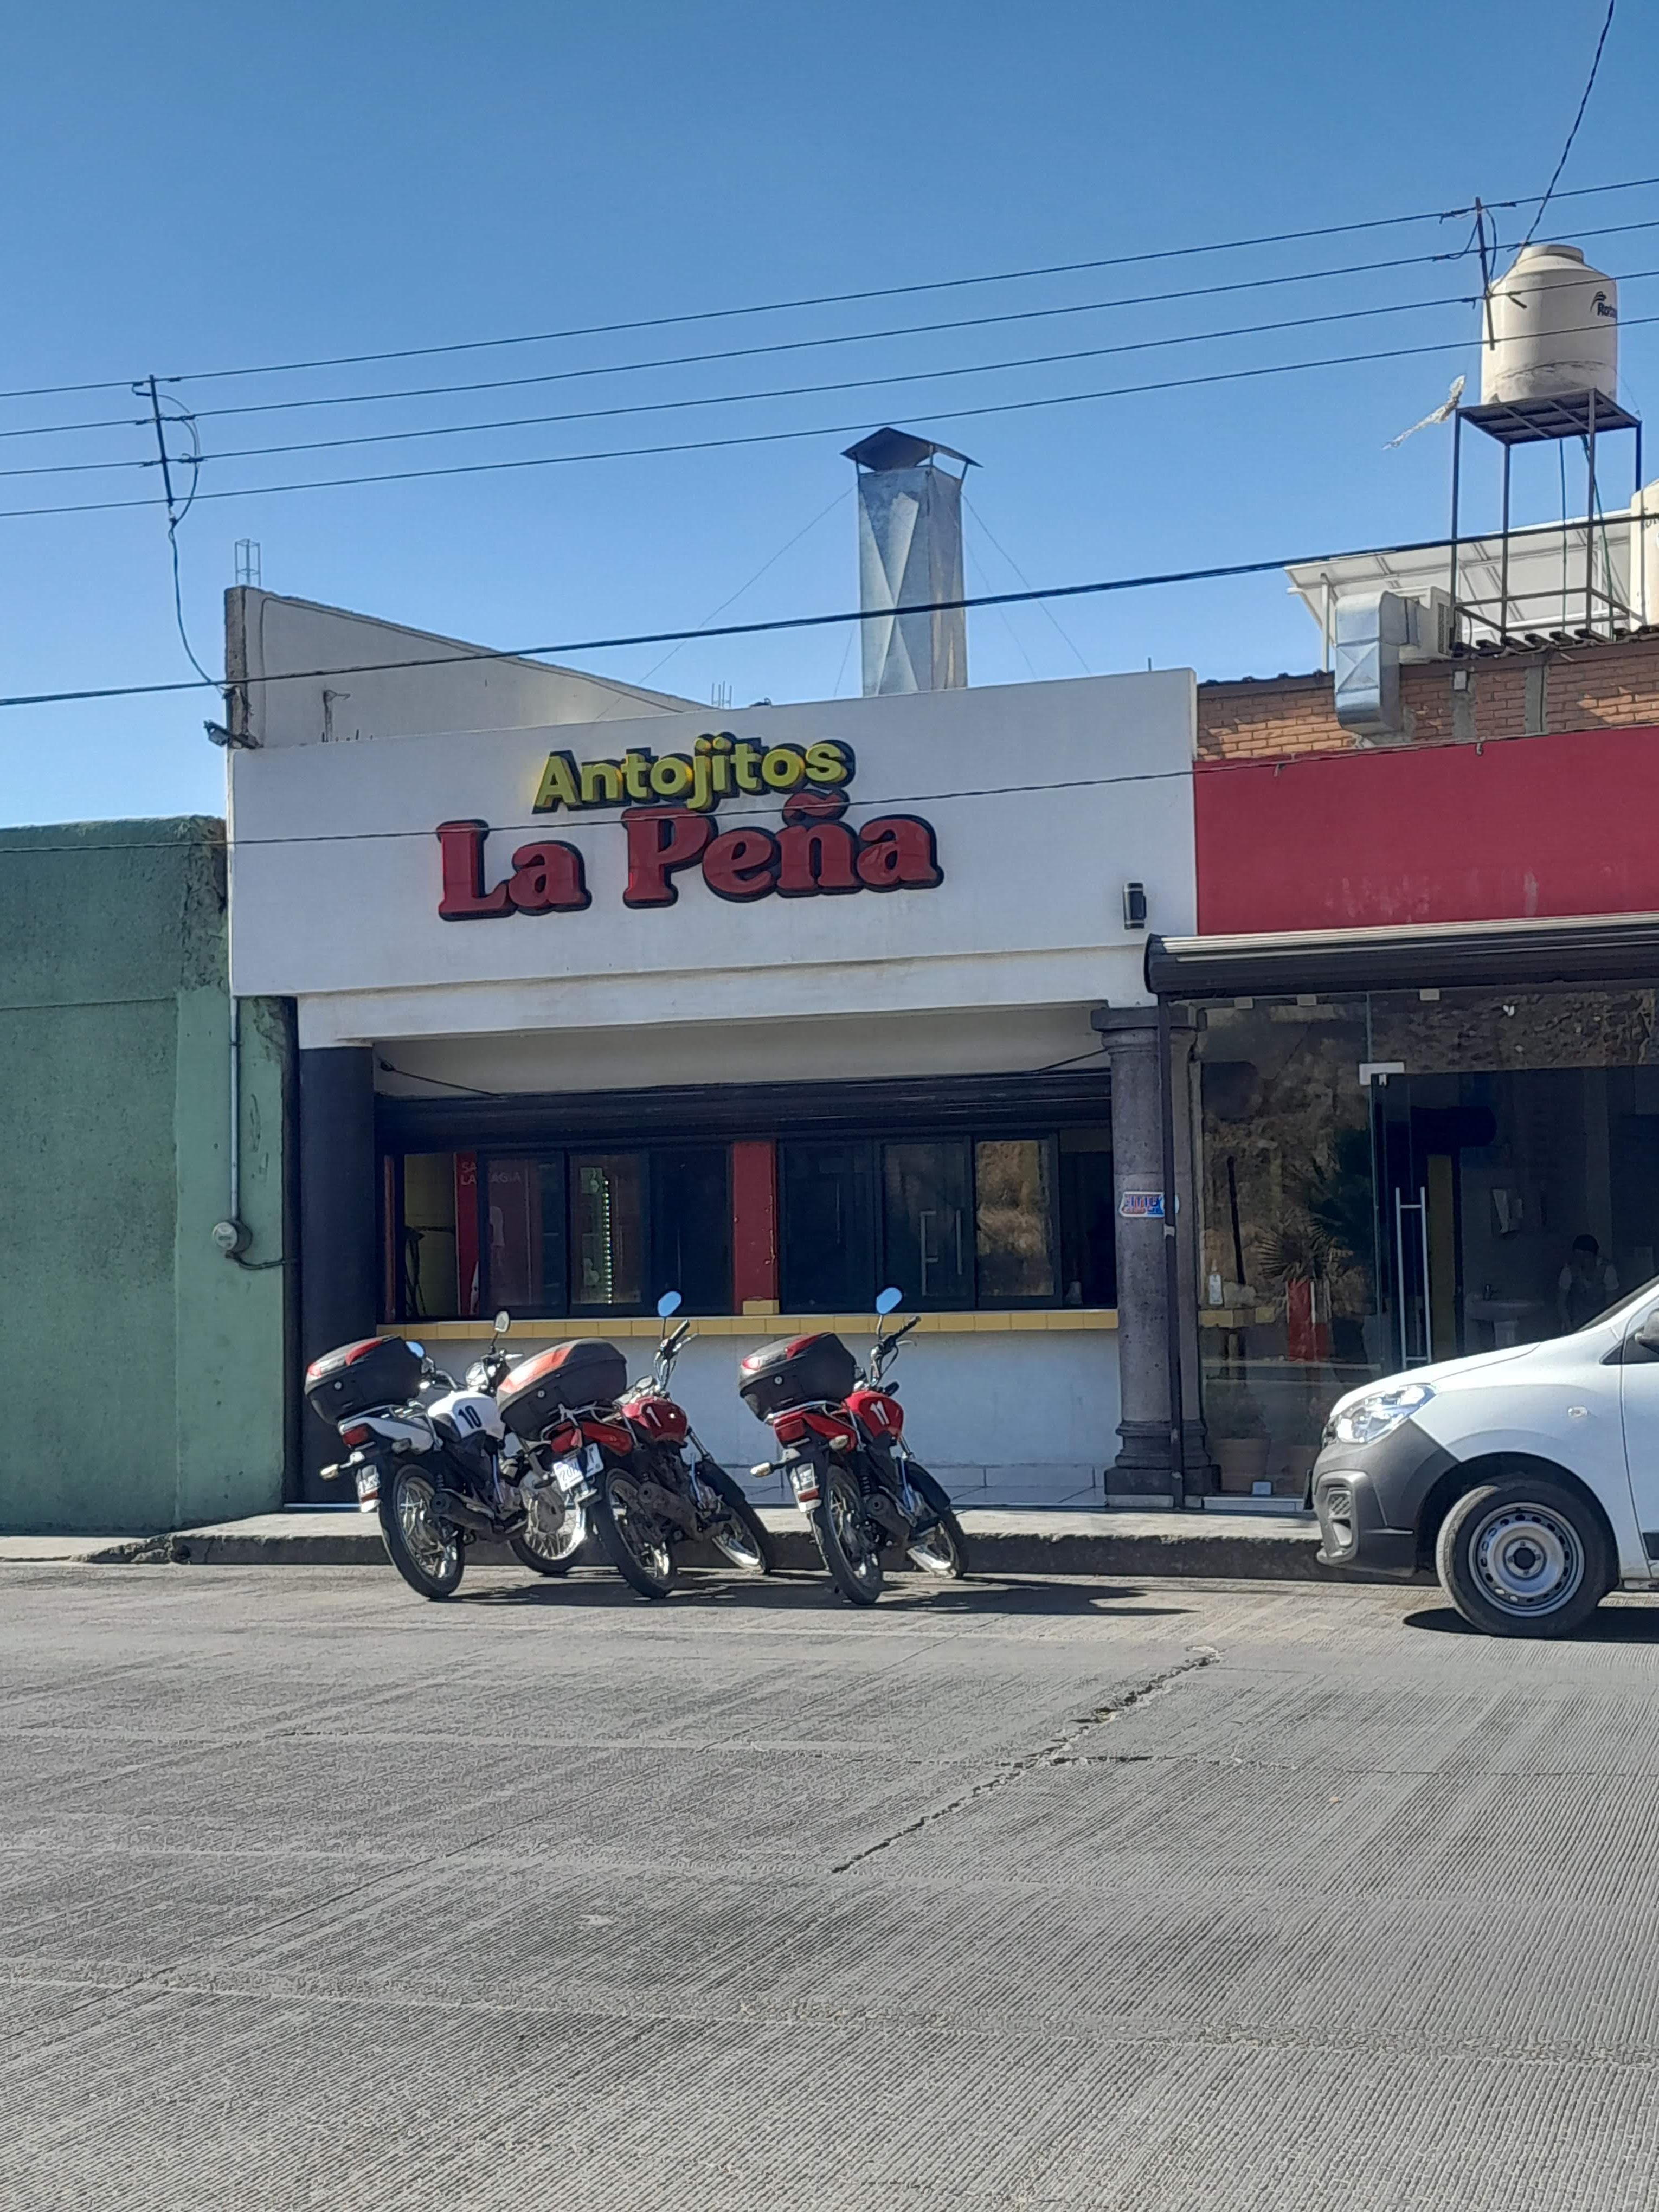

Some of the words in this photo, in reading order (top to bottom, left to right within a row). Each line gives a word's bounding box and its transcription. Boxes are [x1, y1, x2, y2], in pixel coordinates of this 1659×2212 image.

[532, 732, 856, 813] Antojitos
[436, 819, 592, 922] La
[622, 789, 944, 909] Peña
[458, 1405, 483, 1429] 10
[646, 1406, 662, 1427] 1
[869, 1400, 890, 1426] 11
